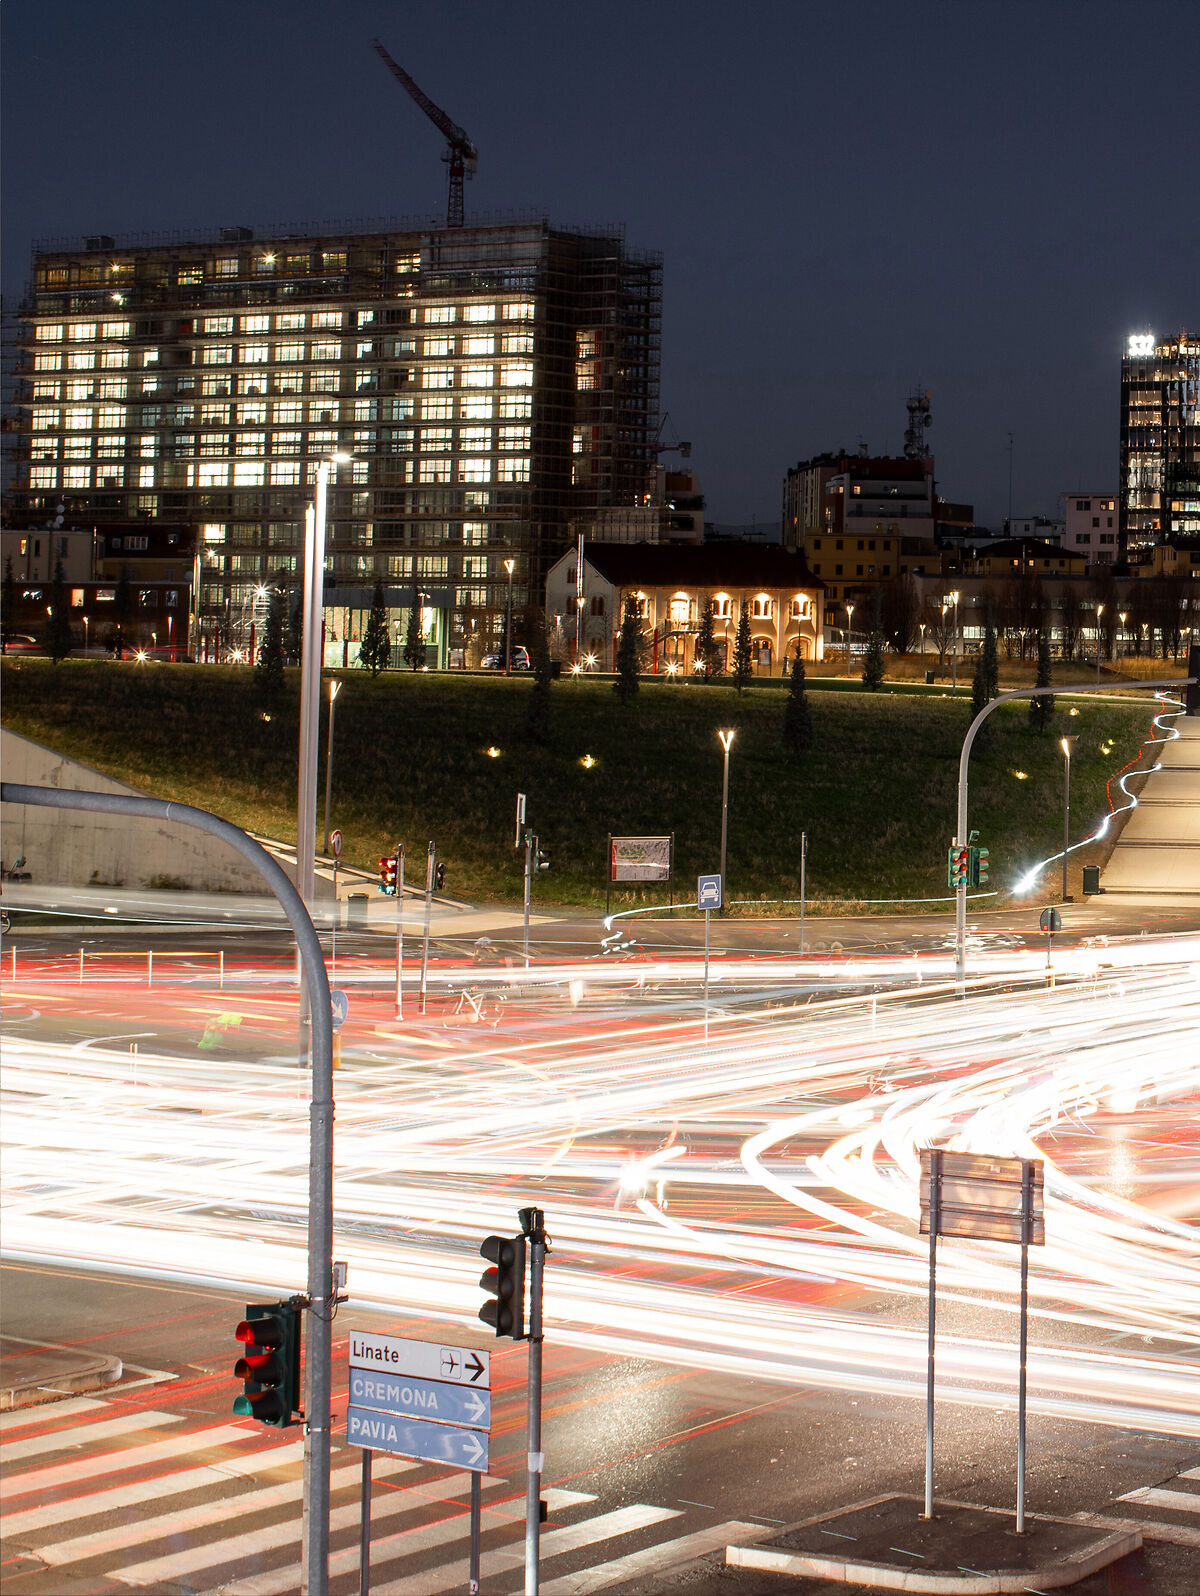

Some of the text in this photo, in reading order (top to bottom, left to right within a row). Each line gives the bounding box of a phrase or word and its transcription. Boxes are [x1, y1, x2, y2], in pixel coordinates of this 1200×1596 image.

[352, 1340, 400, 1362] Linate
[352, 1379, 439, 1409] CREMONA
[350, 1417, 398, 1442] PAVIA
